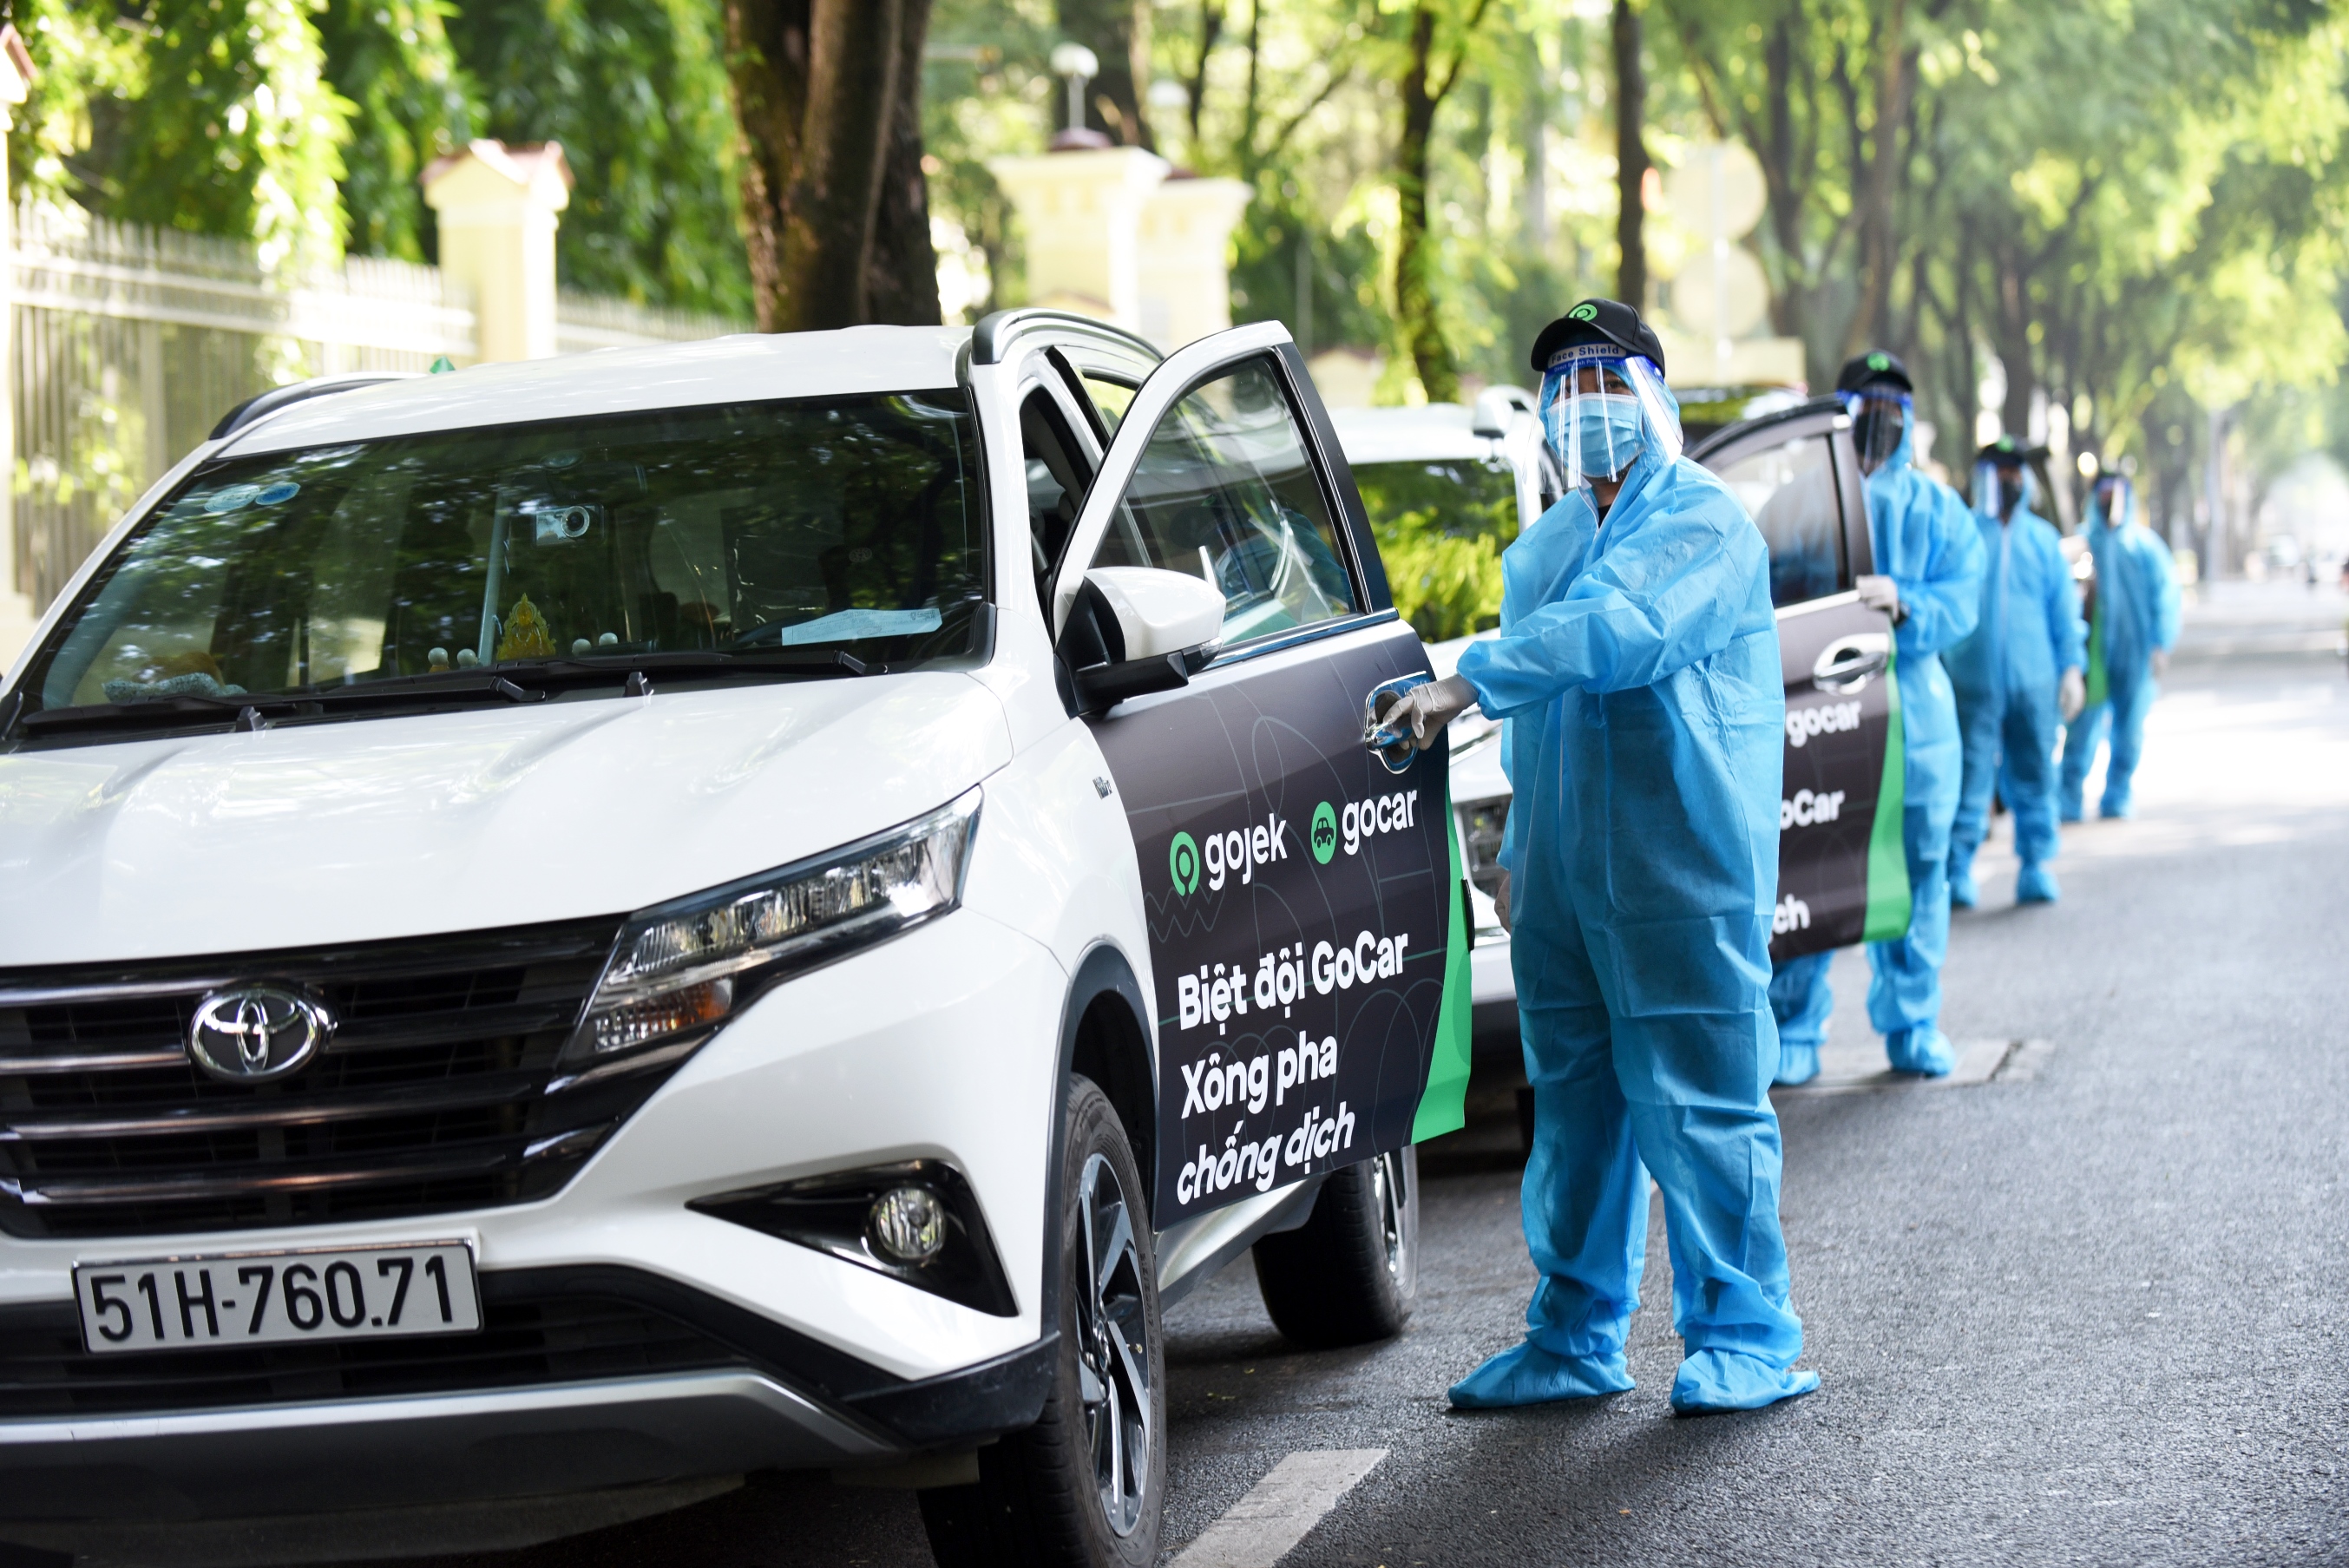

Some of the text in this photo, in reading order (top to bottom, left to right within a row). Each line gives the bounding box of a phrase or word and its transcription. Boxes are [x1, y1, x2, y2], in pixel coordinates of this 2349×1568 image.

[1551, 345, 1619, 364] Face Shield
[1786, 700, 1862, 748] gocar
[1205, 790, 1417, 891] gojek gocar
[1780, 788, 1846, 830] oCar
[1178, 930, 1408, 1036] Biệt đội GoCar
[1180, 1030, 1337, 1119] Xông pha
[1177, 1101, 1355, 1204] chống dịch
[89, 1255, 453, 1342] 51H-760.71
